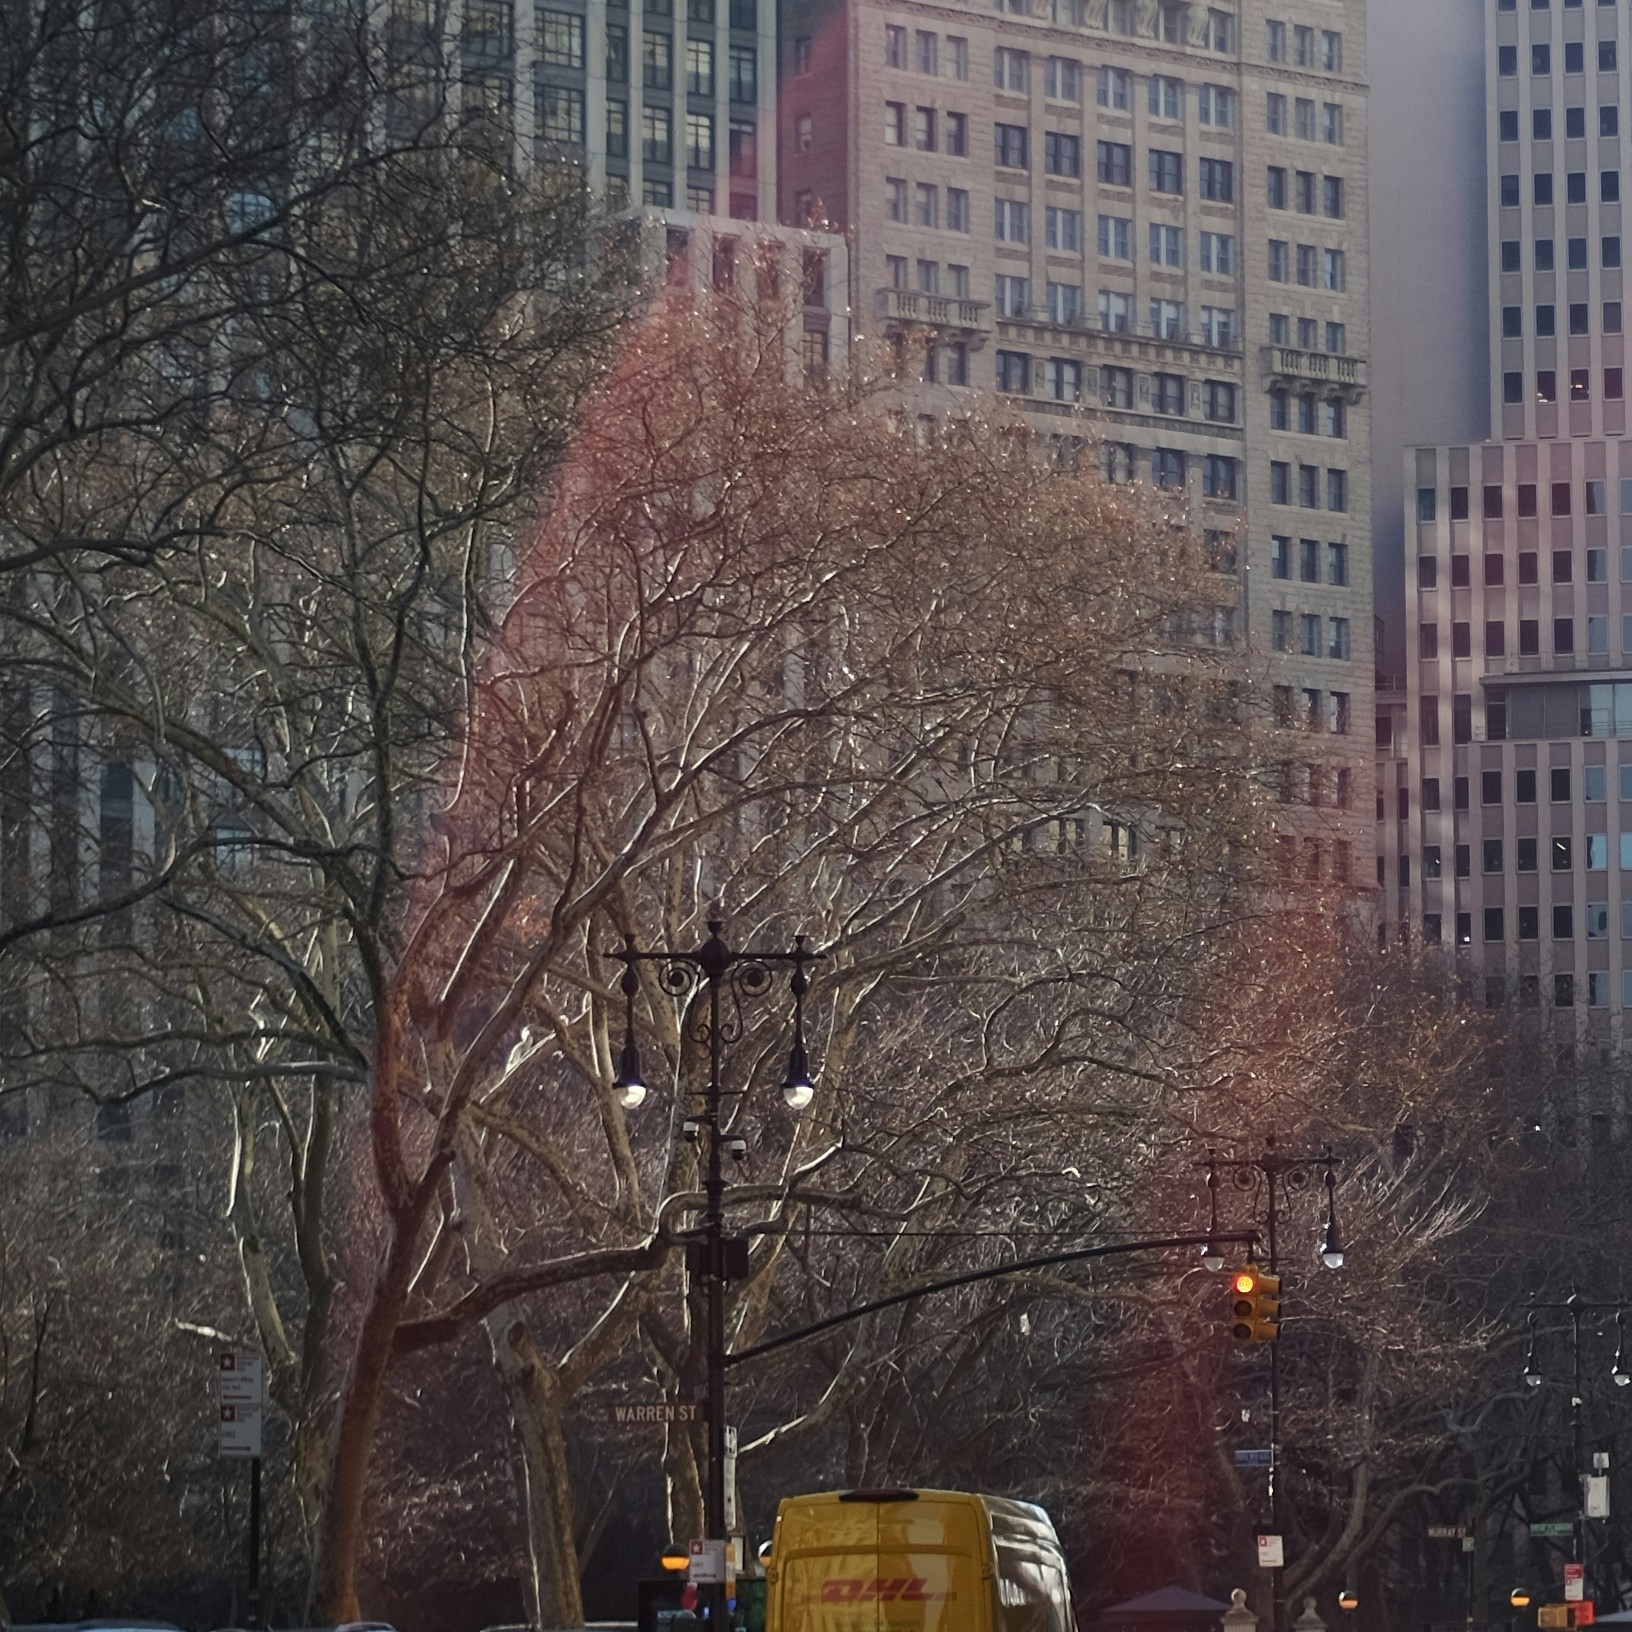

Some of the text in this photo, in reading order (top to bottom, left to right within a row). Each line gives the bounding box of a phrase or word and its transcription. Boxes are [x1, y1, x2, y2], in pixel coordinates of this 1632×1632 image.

[615, 1404, 697, 1422] WARREN ST
[1428, 1525, 1468, 1537] MURRAY ST
[821, 1578, 934, 1603] DHL
